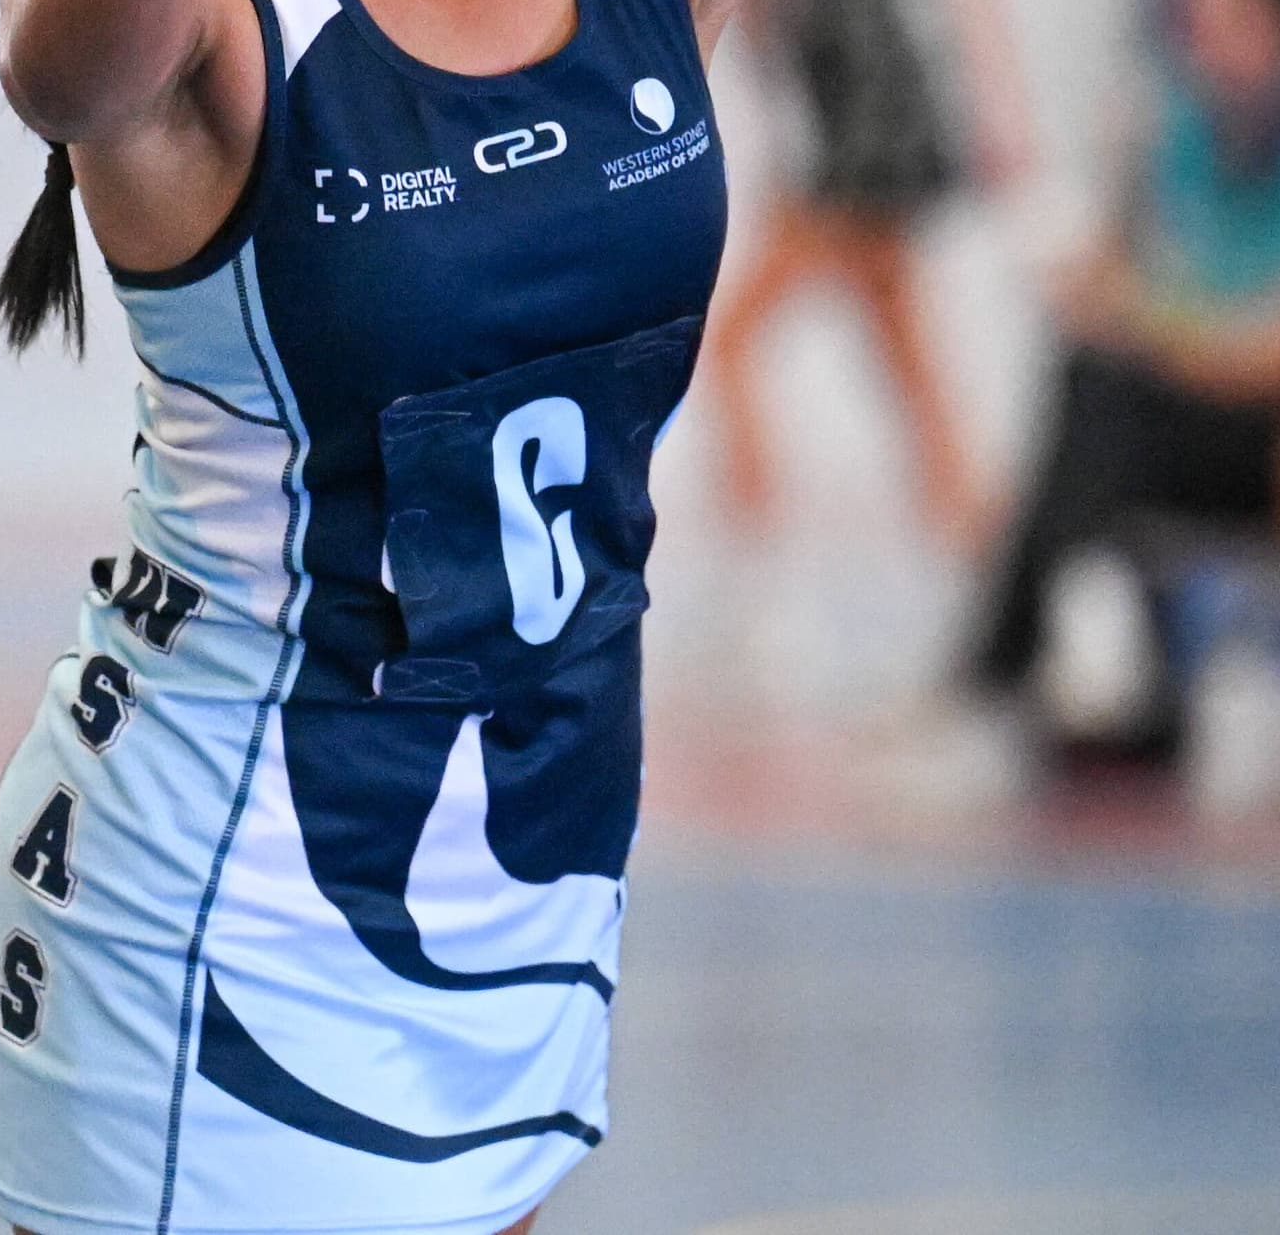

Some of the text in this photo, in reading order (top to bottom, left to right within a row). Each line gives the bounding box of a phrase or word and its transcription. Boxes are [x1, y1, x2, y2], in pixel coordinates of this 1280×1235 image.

[602, 118, 706, 176] WESTERN SYDNEY
[381, 166, 457, 192] DIGITAL
[609, 159, 670, 192] ACADEMY
[671, 152, 687, 168] OF
[384, 184, 456, 212] REALTY
[492, 396, 587, 645] C
